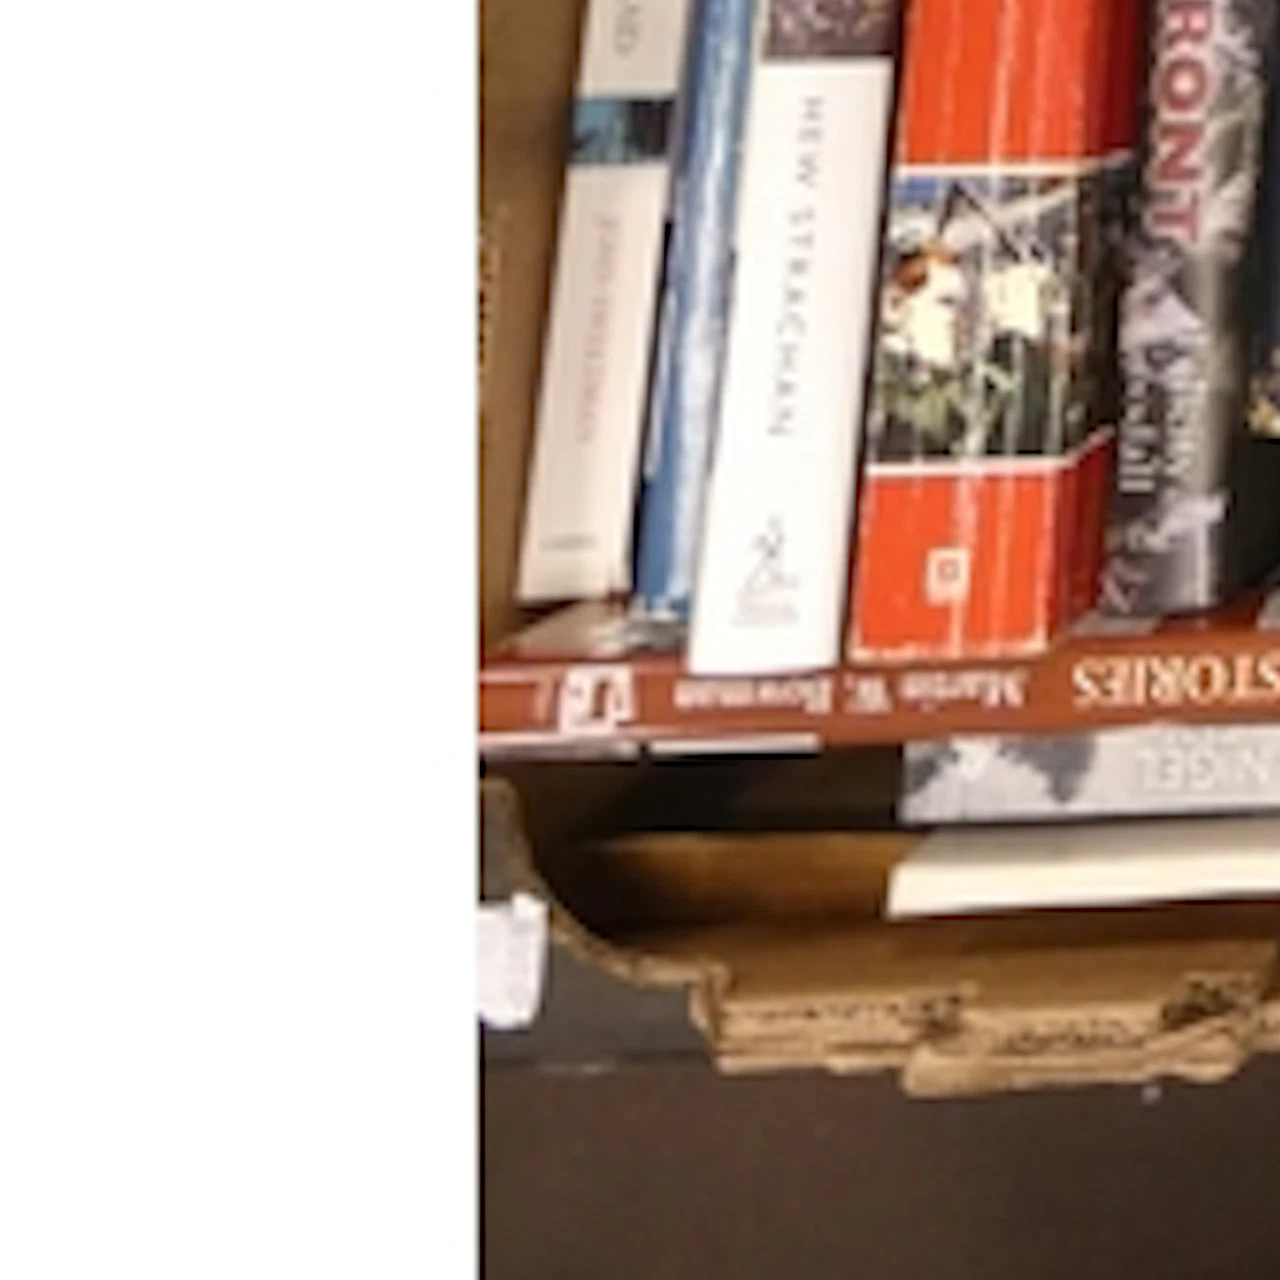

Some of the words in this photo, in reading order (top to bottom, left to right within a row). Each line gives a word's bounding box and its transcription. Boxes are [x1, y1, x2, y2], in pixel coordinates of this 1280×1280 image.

[789, 95, 826, 179] HEW
[763, 204, 817, 442] STRACHAN
[899, 664, 1027, 712] Martin
